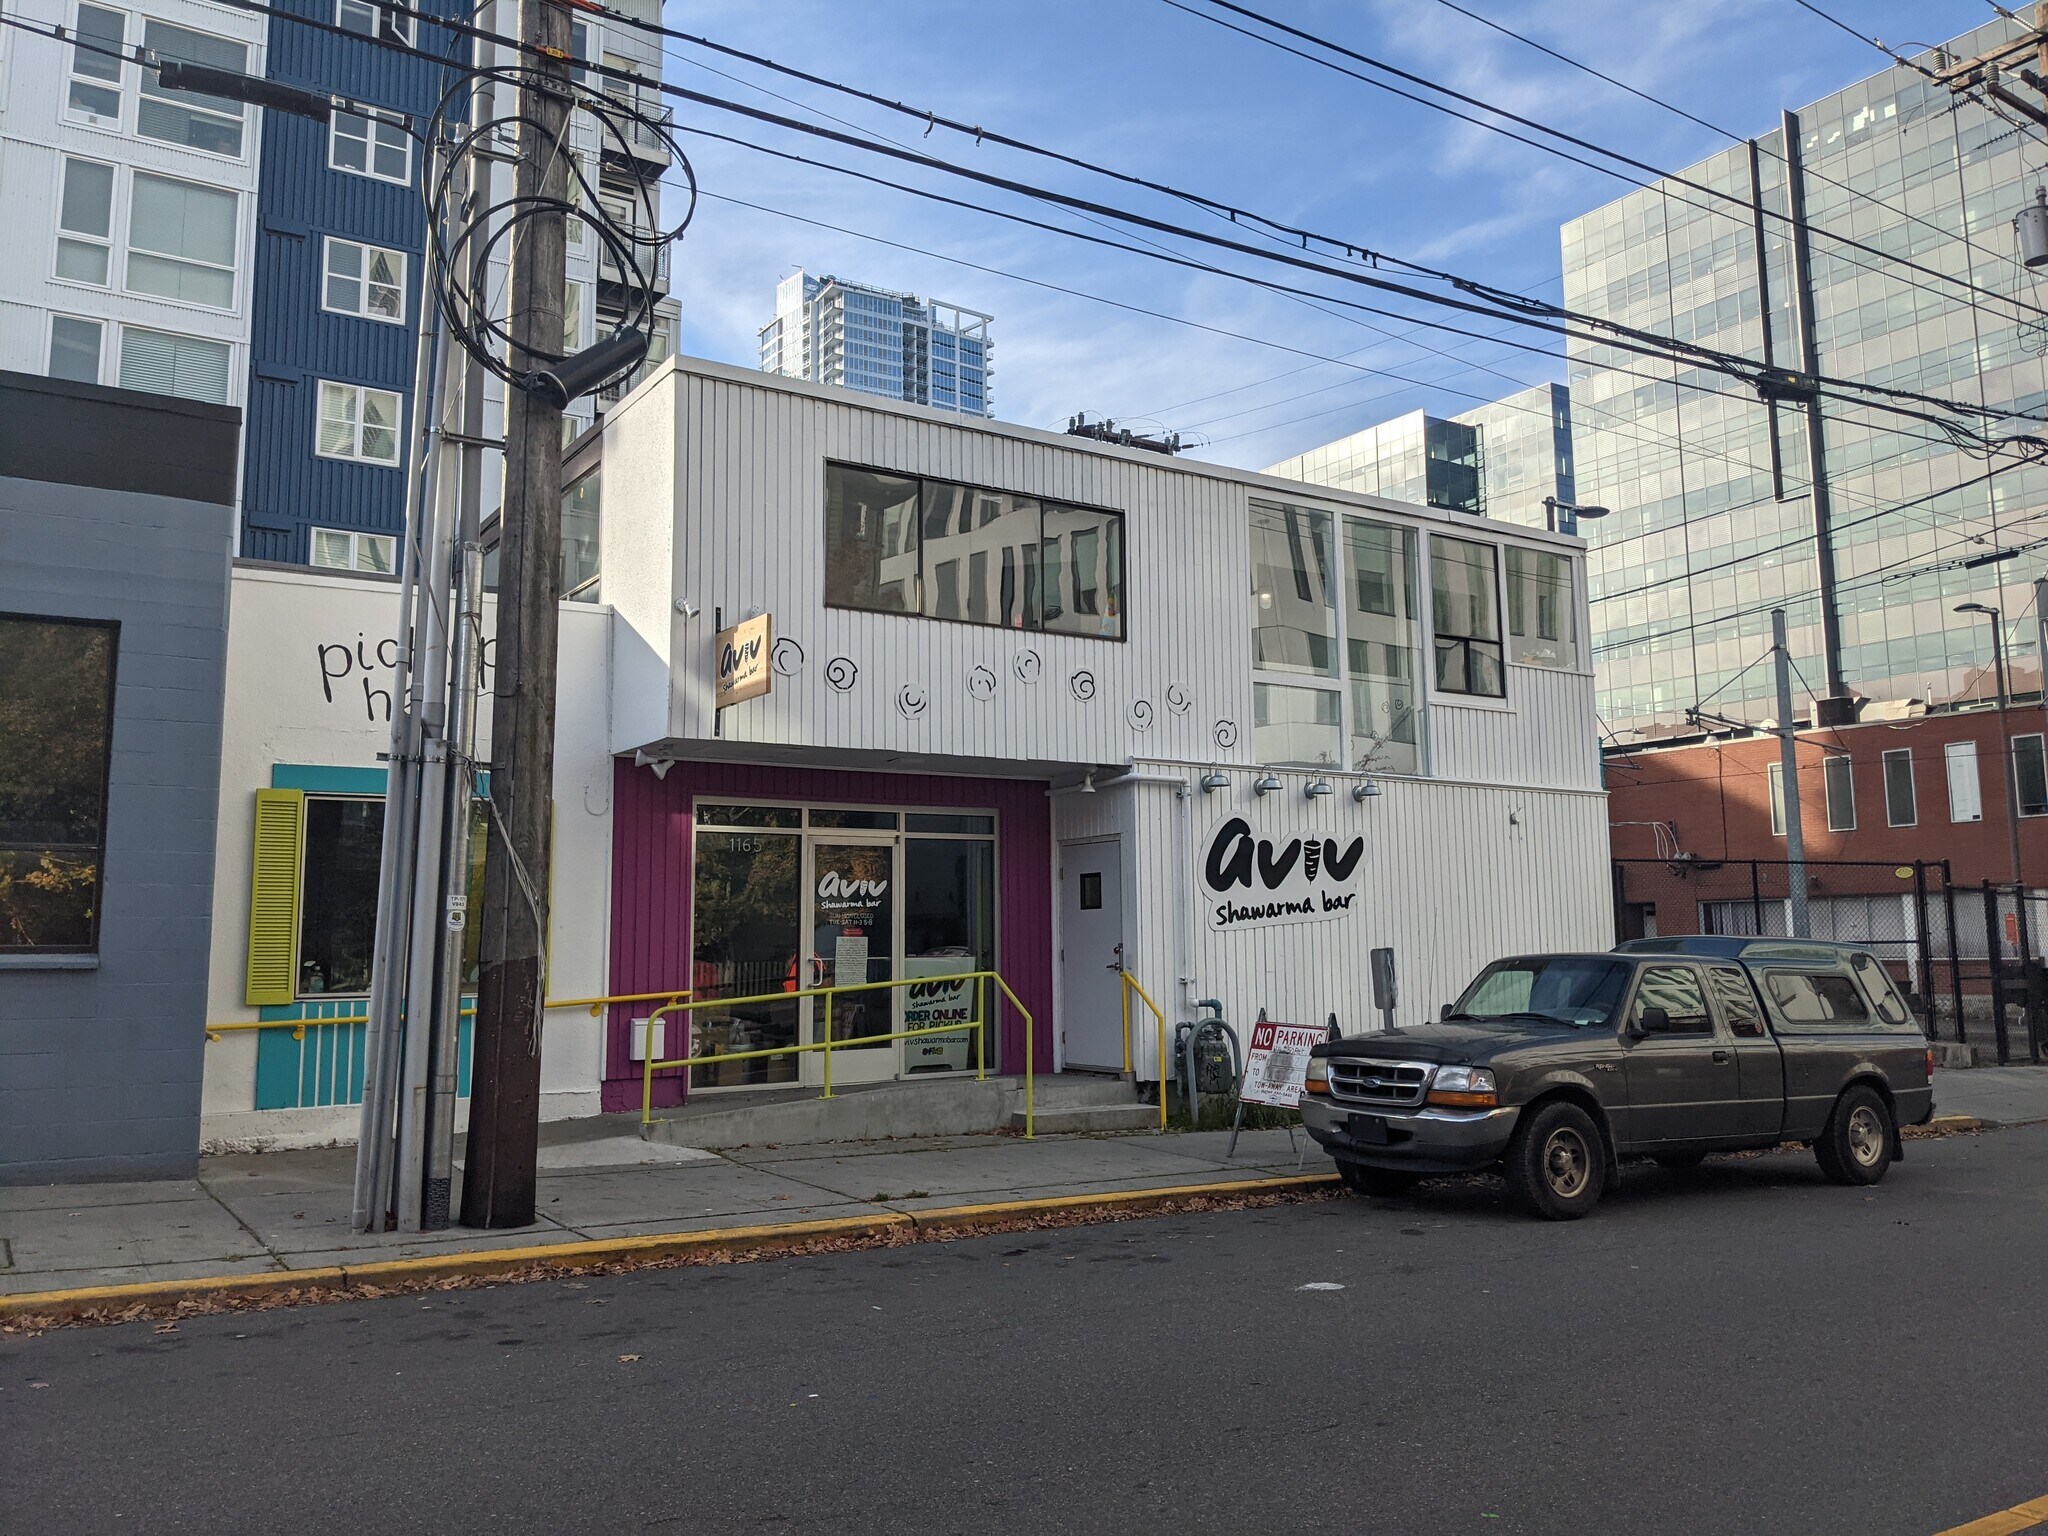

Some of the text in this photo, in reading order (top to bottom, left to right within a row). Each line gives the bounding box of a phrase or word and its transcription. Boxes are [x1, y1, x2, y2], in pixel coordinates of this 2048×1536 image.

[720, 634, 761, 678] aviv
[723, 664, 759, 693] shawarma bar
[729, 838, 762, 852] 1165
[1205, 817, 1365, 893] aviv
[818, 870, 888, 898] aviv
[820, 899, 882, 910] shawarma bar
[1216, 889, 1356, 926] shawarma bar
[932, 1008, 967, 1020] ONLINE
[907, 1021, 926, 1031] FOR
[1255, 1028, 1323, 1047] NO PARKING
[1251, 1052, 1267, 1061] FROM
[1252, 1067, 1260, 1077] TO
[1286, 1085, 1302, 1093] AREA
